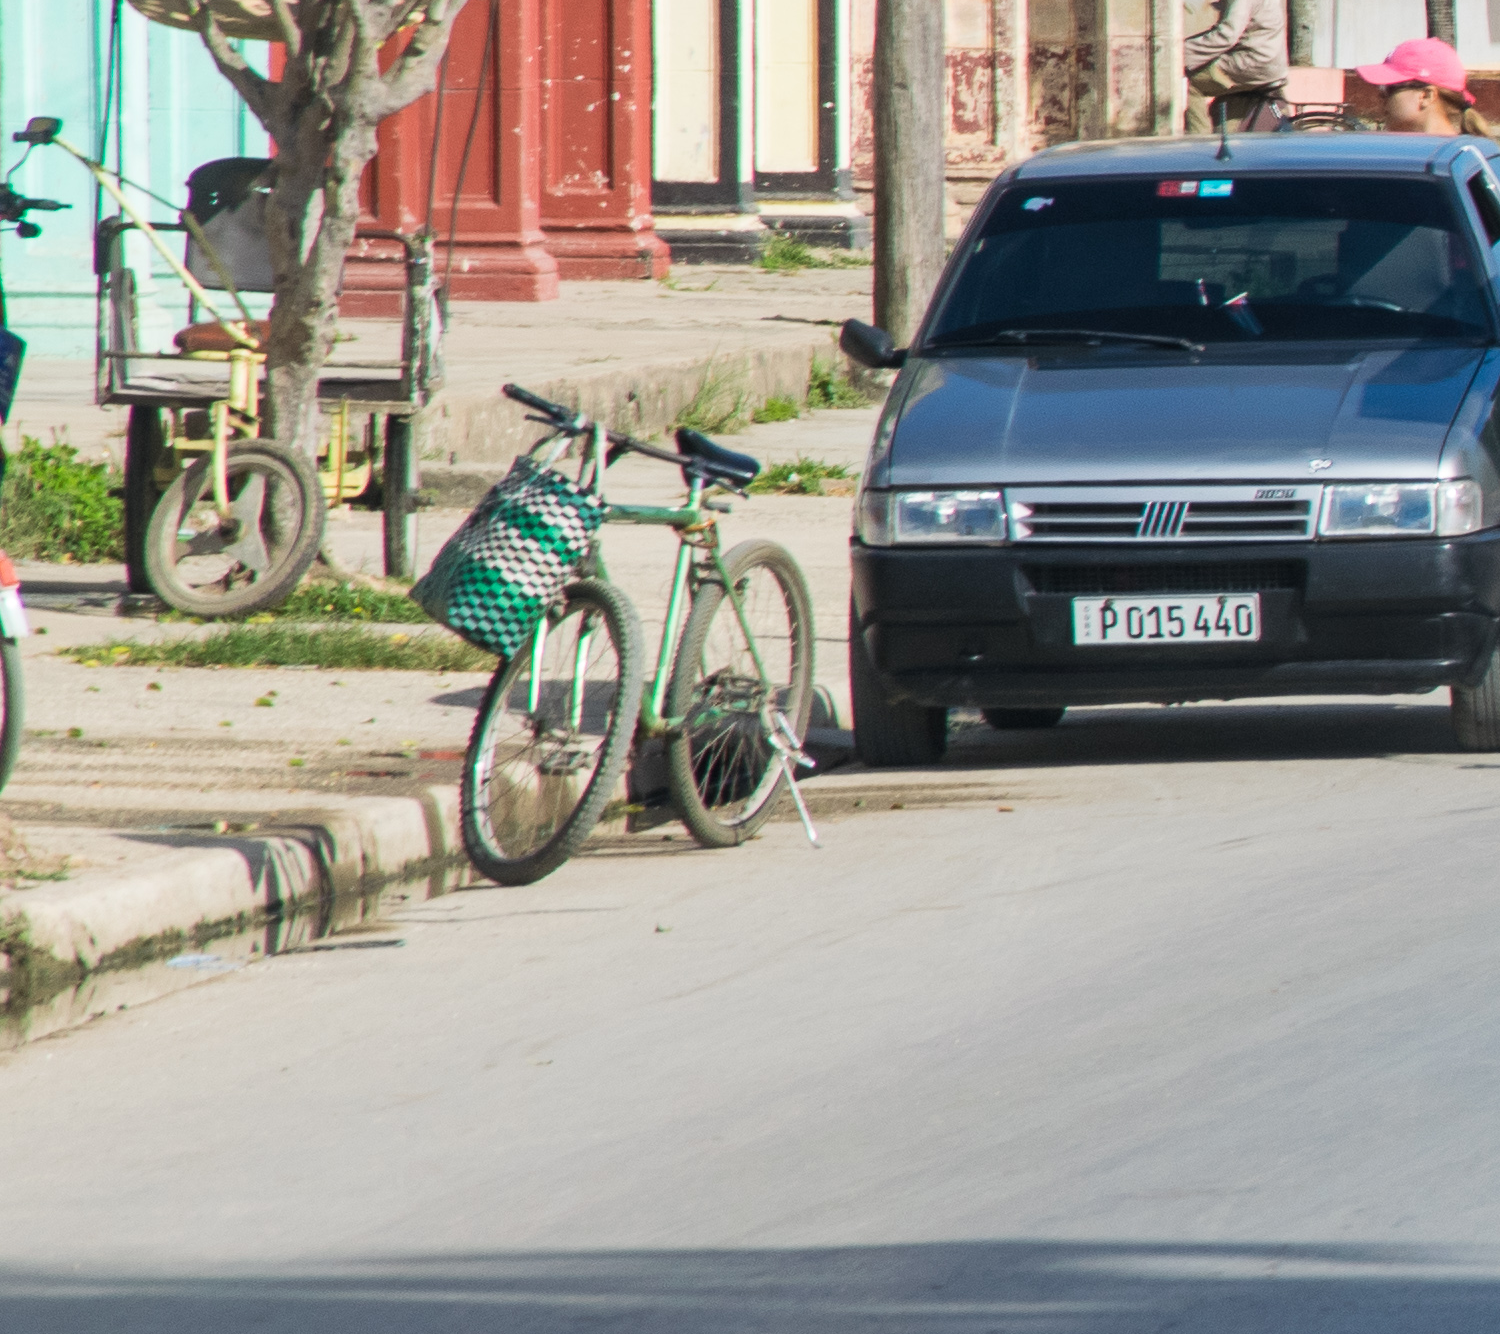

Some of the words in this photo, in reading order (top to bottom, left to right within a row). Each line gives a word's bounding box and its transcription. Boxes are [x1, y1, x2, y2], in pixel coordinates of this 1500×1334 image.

[1099, 601, 1118, 640] P
[1126, 605, 1185, 639] 015
[1193, 601, 1253, 637] 440
